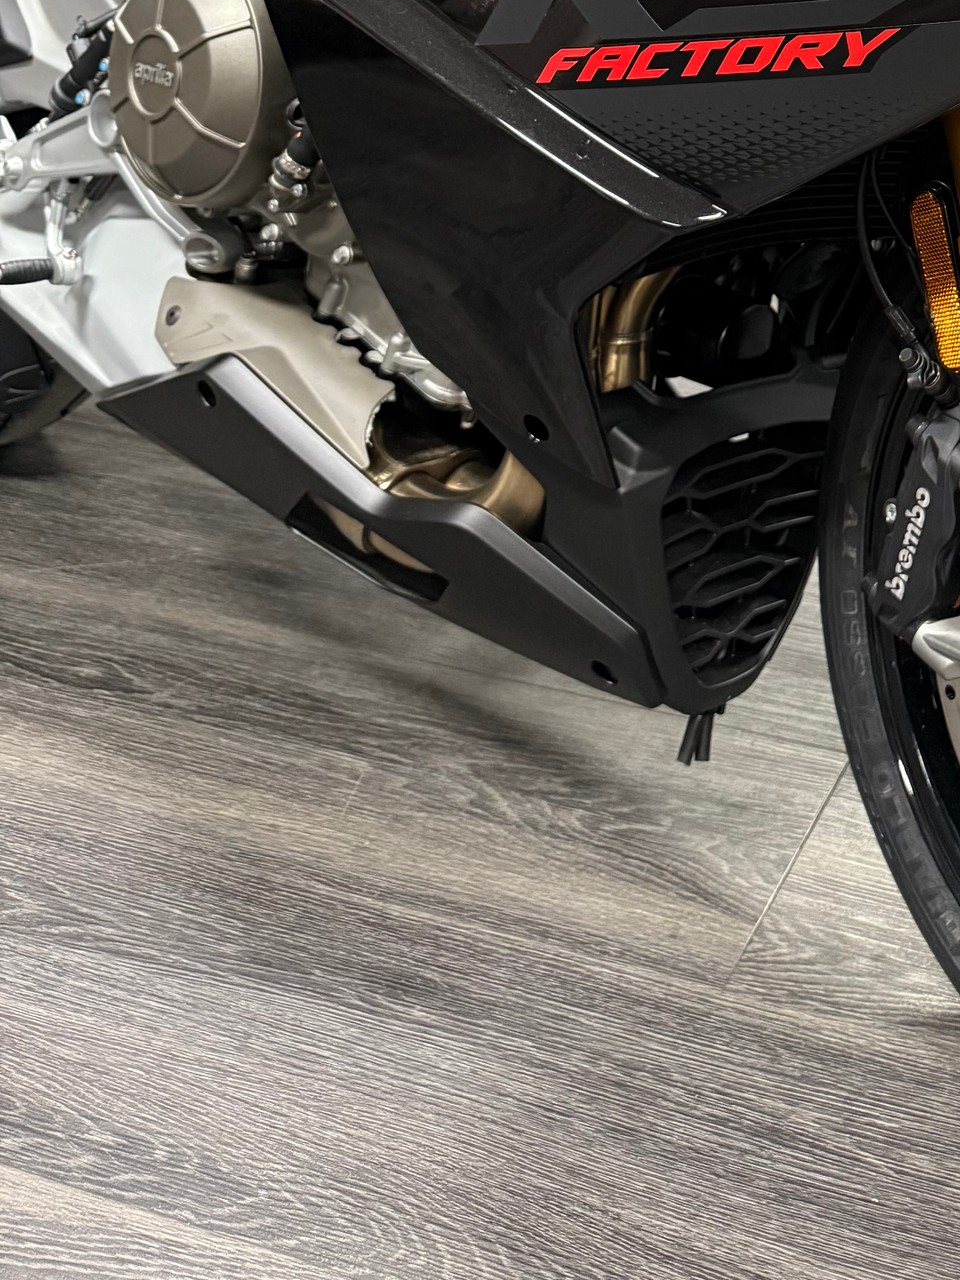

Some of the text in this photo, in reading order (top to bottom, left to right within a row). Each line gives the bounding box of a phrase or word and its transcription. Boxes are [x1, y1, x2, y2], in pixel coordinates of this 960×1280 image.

[134, 62, 174, 87] aprilia
[535, 27, 901, 84] FACTORY
[884, 486, 931, 601] brembo
